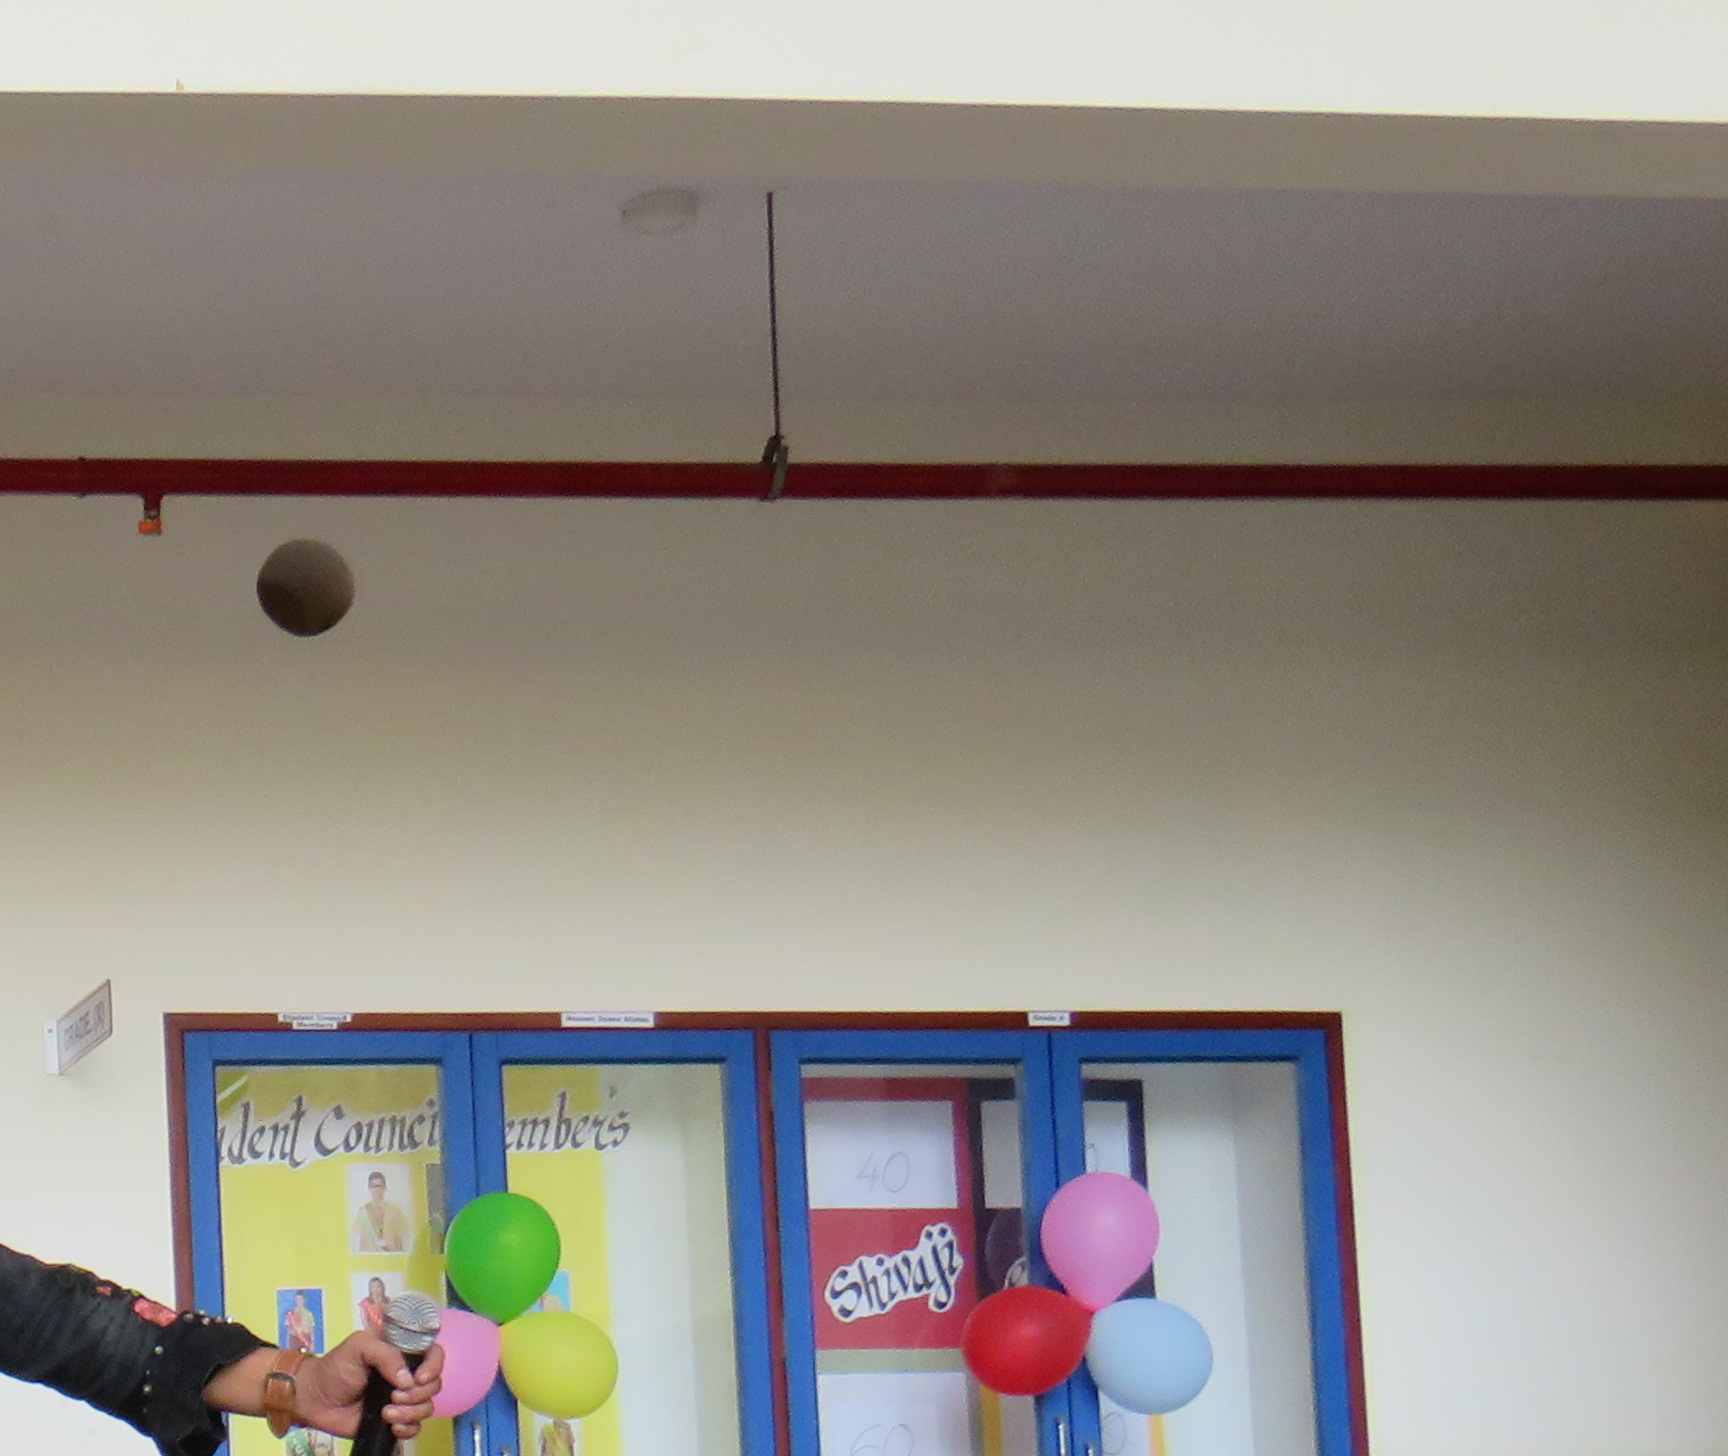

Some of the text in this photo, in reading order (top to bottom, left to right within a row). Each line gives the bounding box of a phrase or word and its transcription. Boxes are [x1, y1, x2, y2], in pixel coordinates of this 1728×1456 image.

[314, 1098, 440, 1157] Counci
[856, 1151, 910, 1194] 40
[829, 1226, 960, 1315] Shivaji
